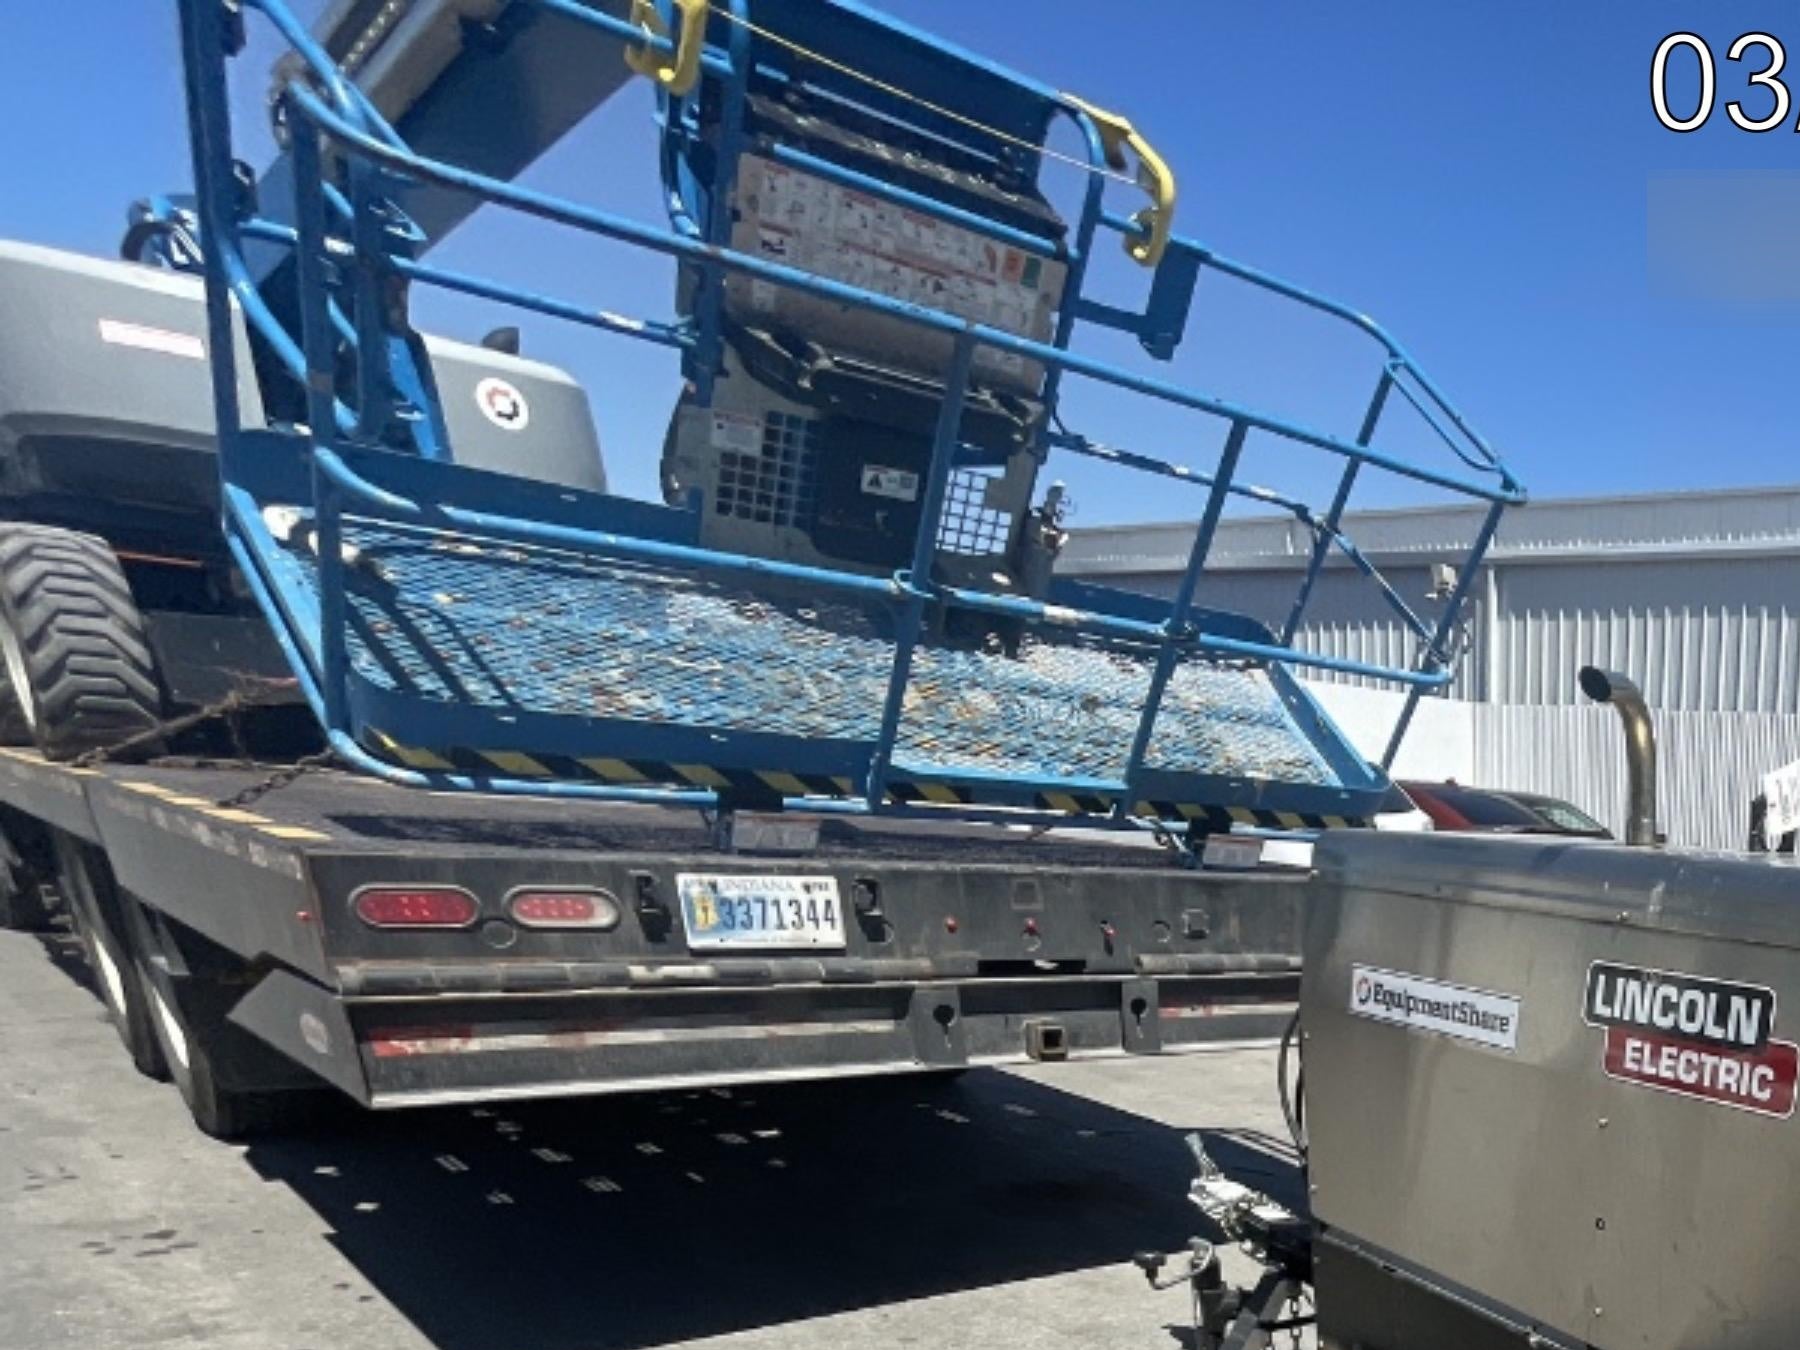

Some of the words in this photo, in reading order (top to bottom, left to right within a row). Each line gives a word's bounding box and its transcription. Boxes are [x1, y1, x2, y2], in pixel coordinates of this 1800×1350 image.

[720, 896, 838, 931] 3371344
[1373, 982, 1510, 1033] EquipmentShare
[1594, 973, 1762, 1045] LINCOLN
[1624, 1037, 1775, 1102] ELECTRIC
